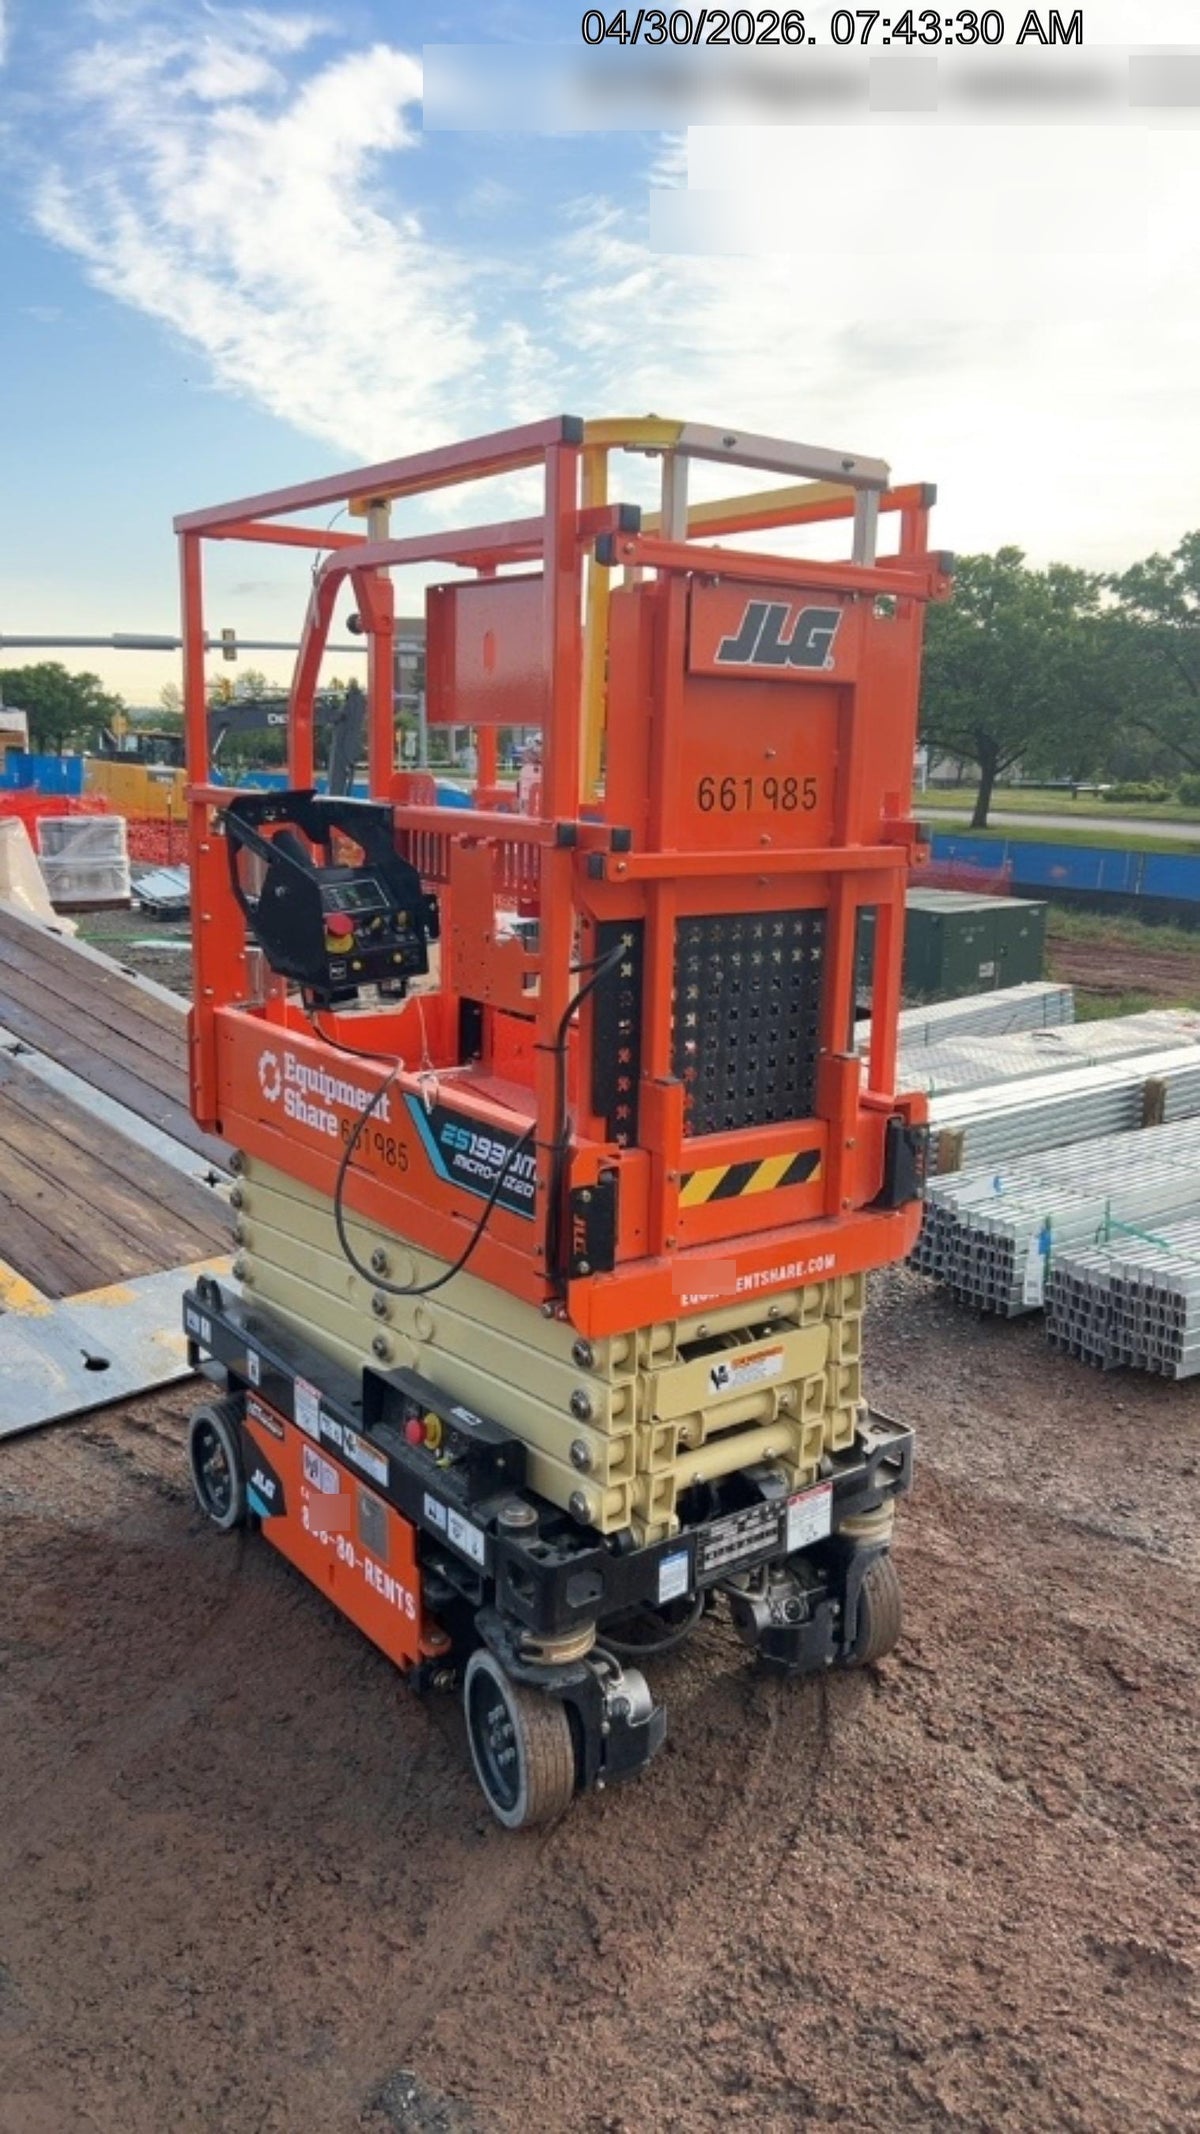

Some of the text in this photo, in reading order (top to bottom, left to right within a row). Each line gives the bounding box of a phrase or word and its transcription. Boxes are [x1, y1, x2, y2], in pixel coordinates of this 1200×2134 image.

[714, 599, 844, 671] JLG
[697, 777, 818, 811] 661985
[283, 1087, 339, 1137] Share
